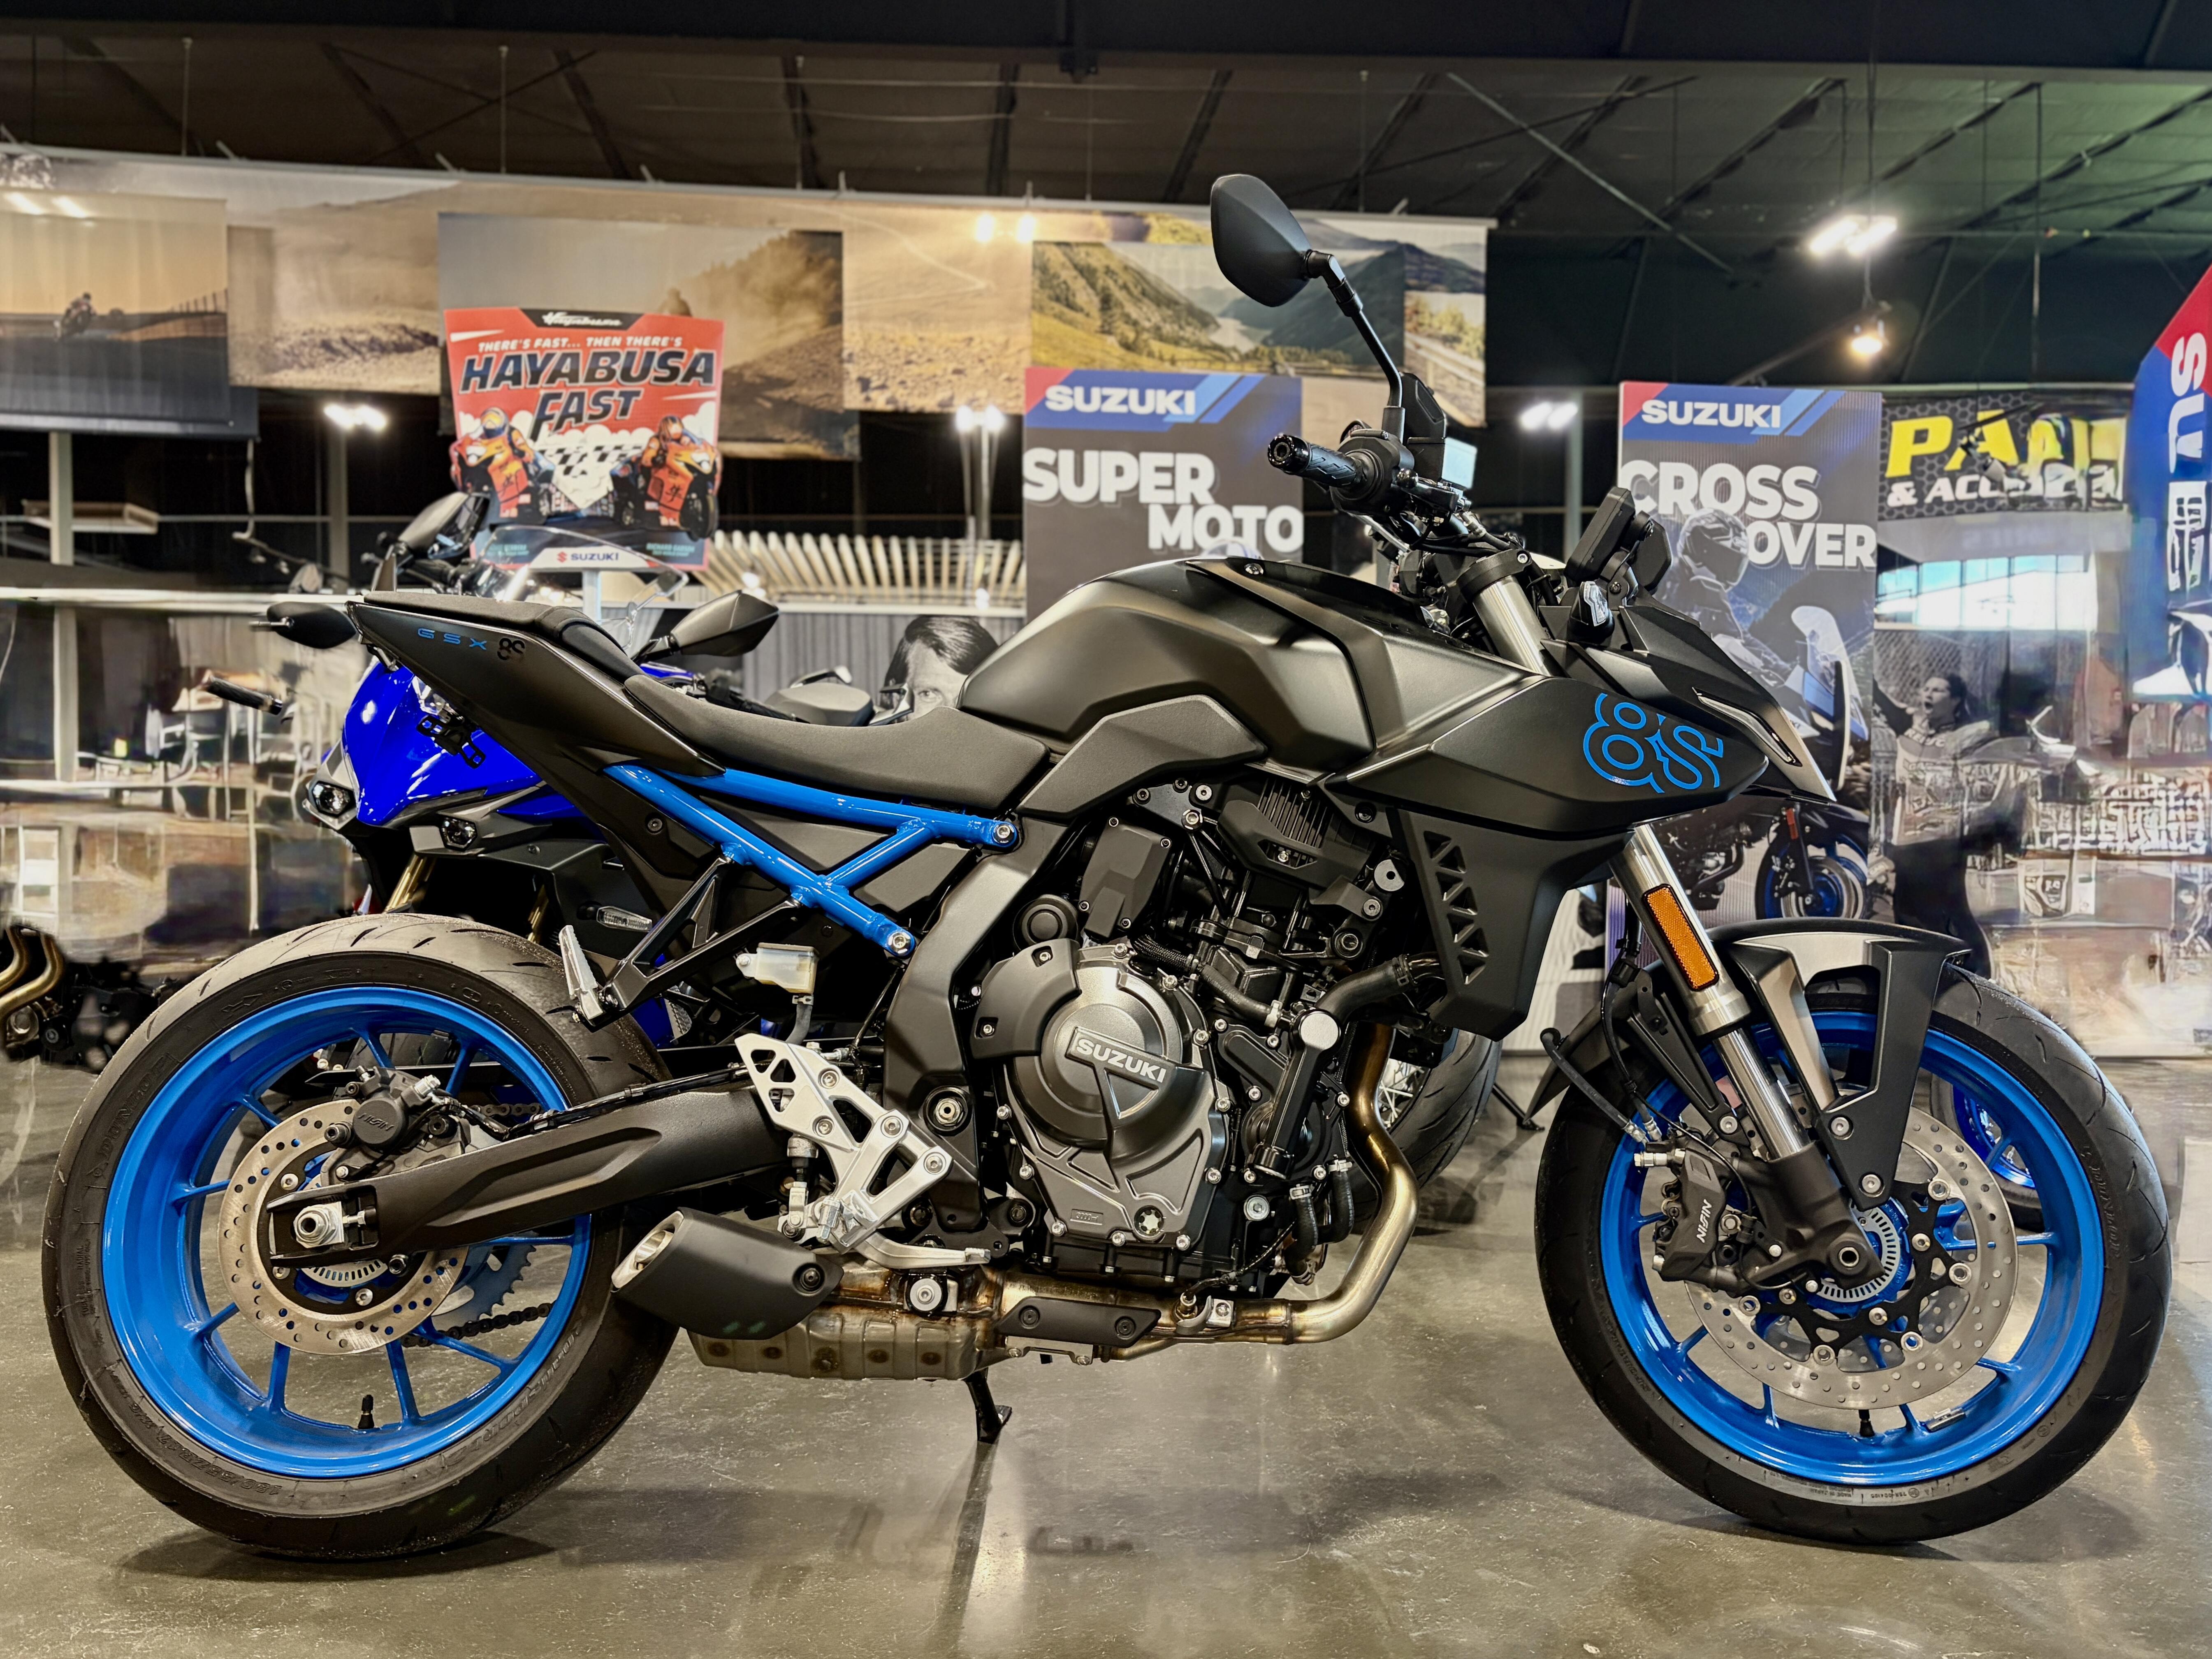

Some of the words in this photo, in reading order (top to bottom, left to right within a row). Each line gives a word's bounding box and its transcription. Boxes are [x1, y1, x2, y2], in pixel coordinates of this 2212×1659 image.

[478, 338, 531, 352] THERE'S
[586, 336, 621, 347] THEN
[626, 336, 683, 347] THERE'S
[459, 348, 717, 396] HAYABUSA
[528, 387, 644, 443] FAST
[1045, 385, 1195, 415] SUZUKI
[1642, 400, 1781, 428] SUZUKI
[1023, 448, 1215, 505] SUPER
[1620, 460, 1819, 520] CROSS
[1148, 504, 1304, 553] MOTO
[1747, 521, 1877, 568] OVER
[418, 628, 487, 651] GSX
[1076, 1039, 1166, 1083] SUZUKI
